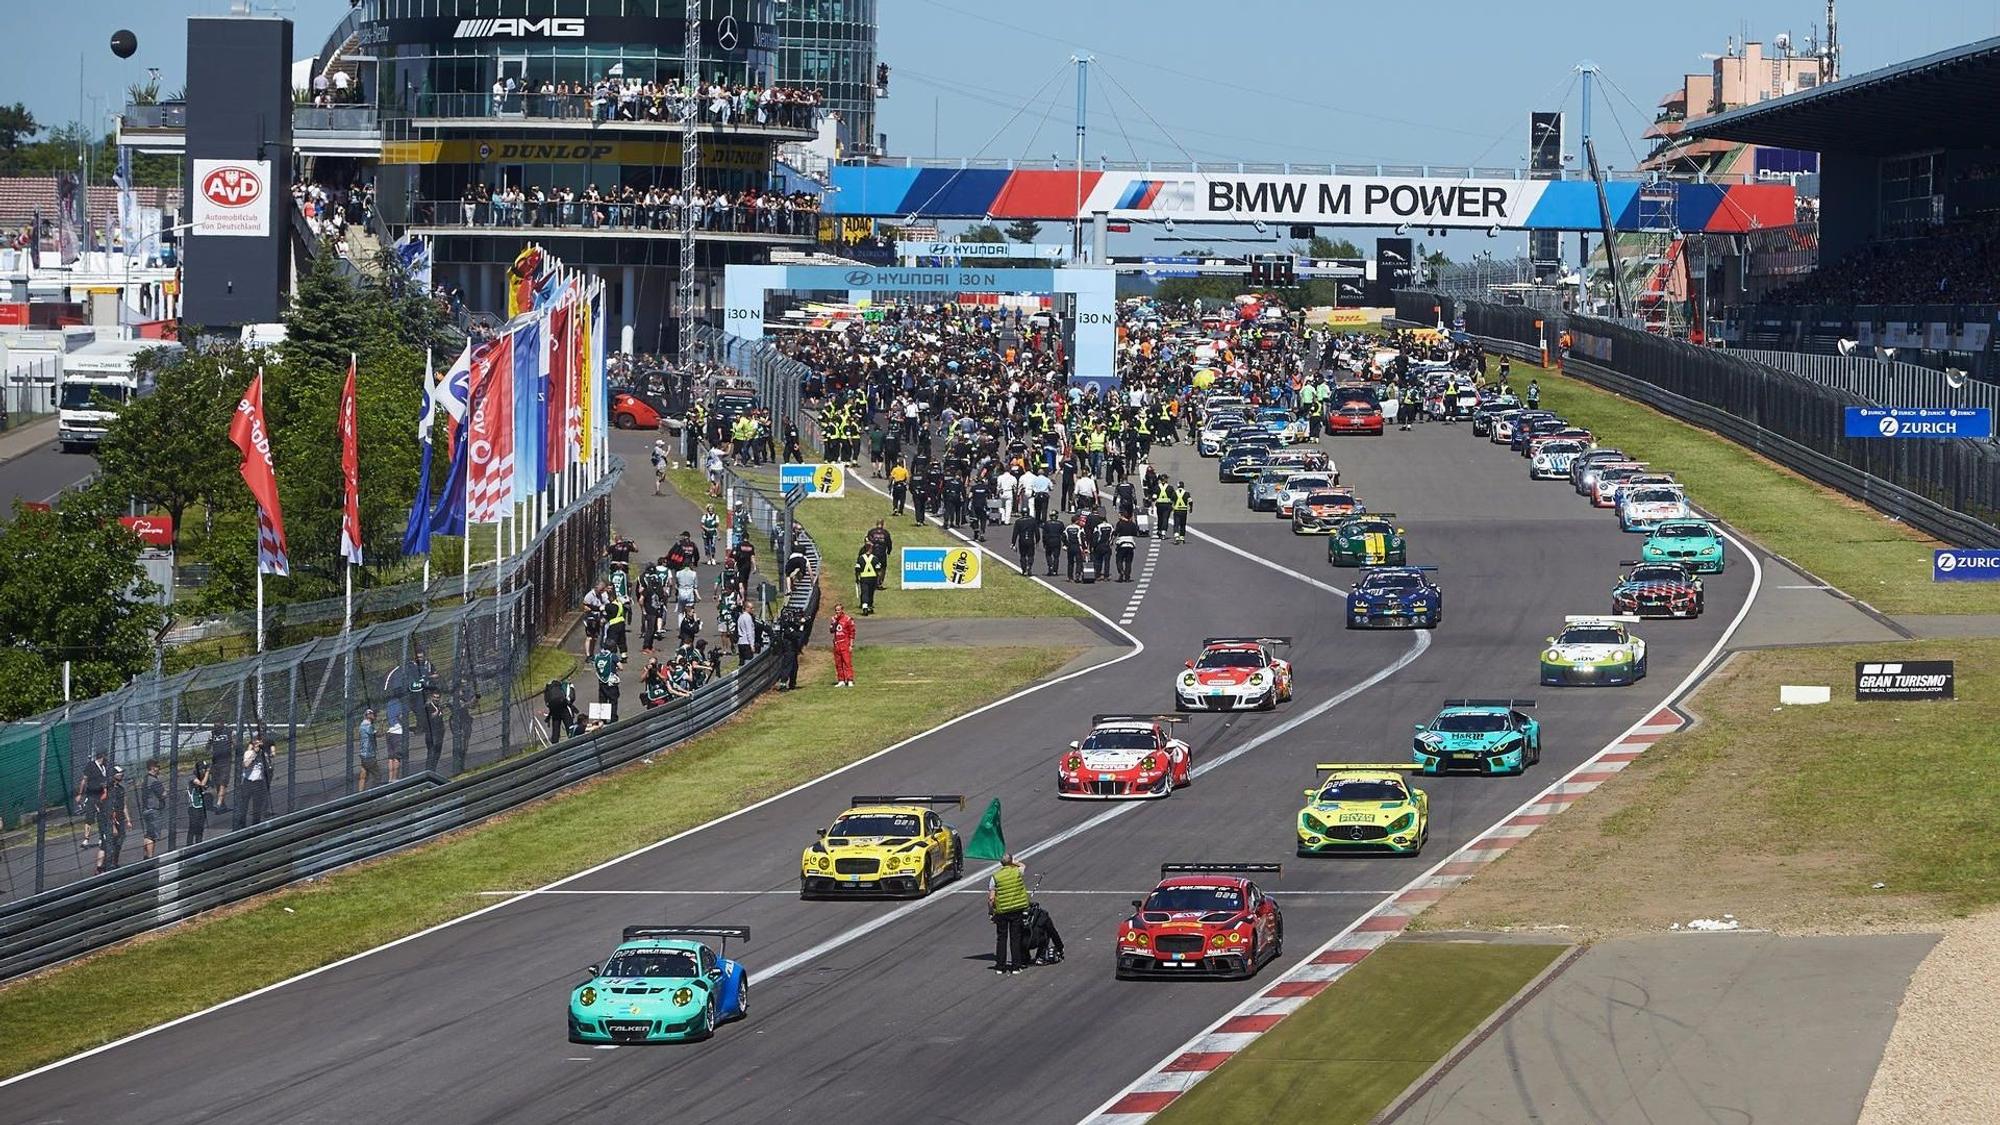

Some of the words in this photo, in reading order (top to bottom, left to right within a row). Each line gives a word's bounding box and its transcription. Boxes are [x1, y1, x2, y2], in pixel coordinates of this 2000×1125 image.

[490, 18, 585, 37] AMG
[500, 144, 613, 159] DUNLOP
[1208, 181, 1306, 214] BMW
[1318, 184, 1351, 215] M
[1365, 184, 1508, 218] POWER
[845, 217, 873, 232] ADAC
[953, 245, 1008, 255] HYUNDAI
[877, 274, 949, 286] HYUNDAI
[959, 273, 982, 286] i30
[985, 274, 995, 286] N
[728, 308, 748, 319] i30
[750, 309, 760, 319] N
[1079, 313, 1099, 324] i30
[1102, 314, 1112, 324] N
[1901, 422, 1957, 433] ZURICH
[782, 475, 812, 484] BILSTEIN
[905, 561, 942, 571] BILSTEIN
[1957, 557, 2000, 568] ZURIC
[1860, 676, 1893, 688] GRAN
